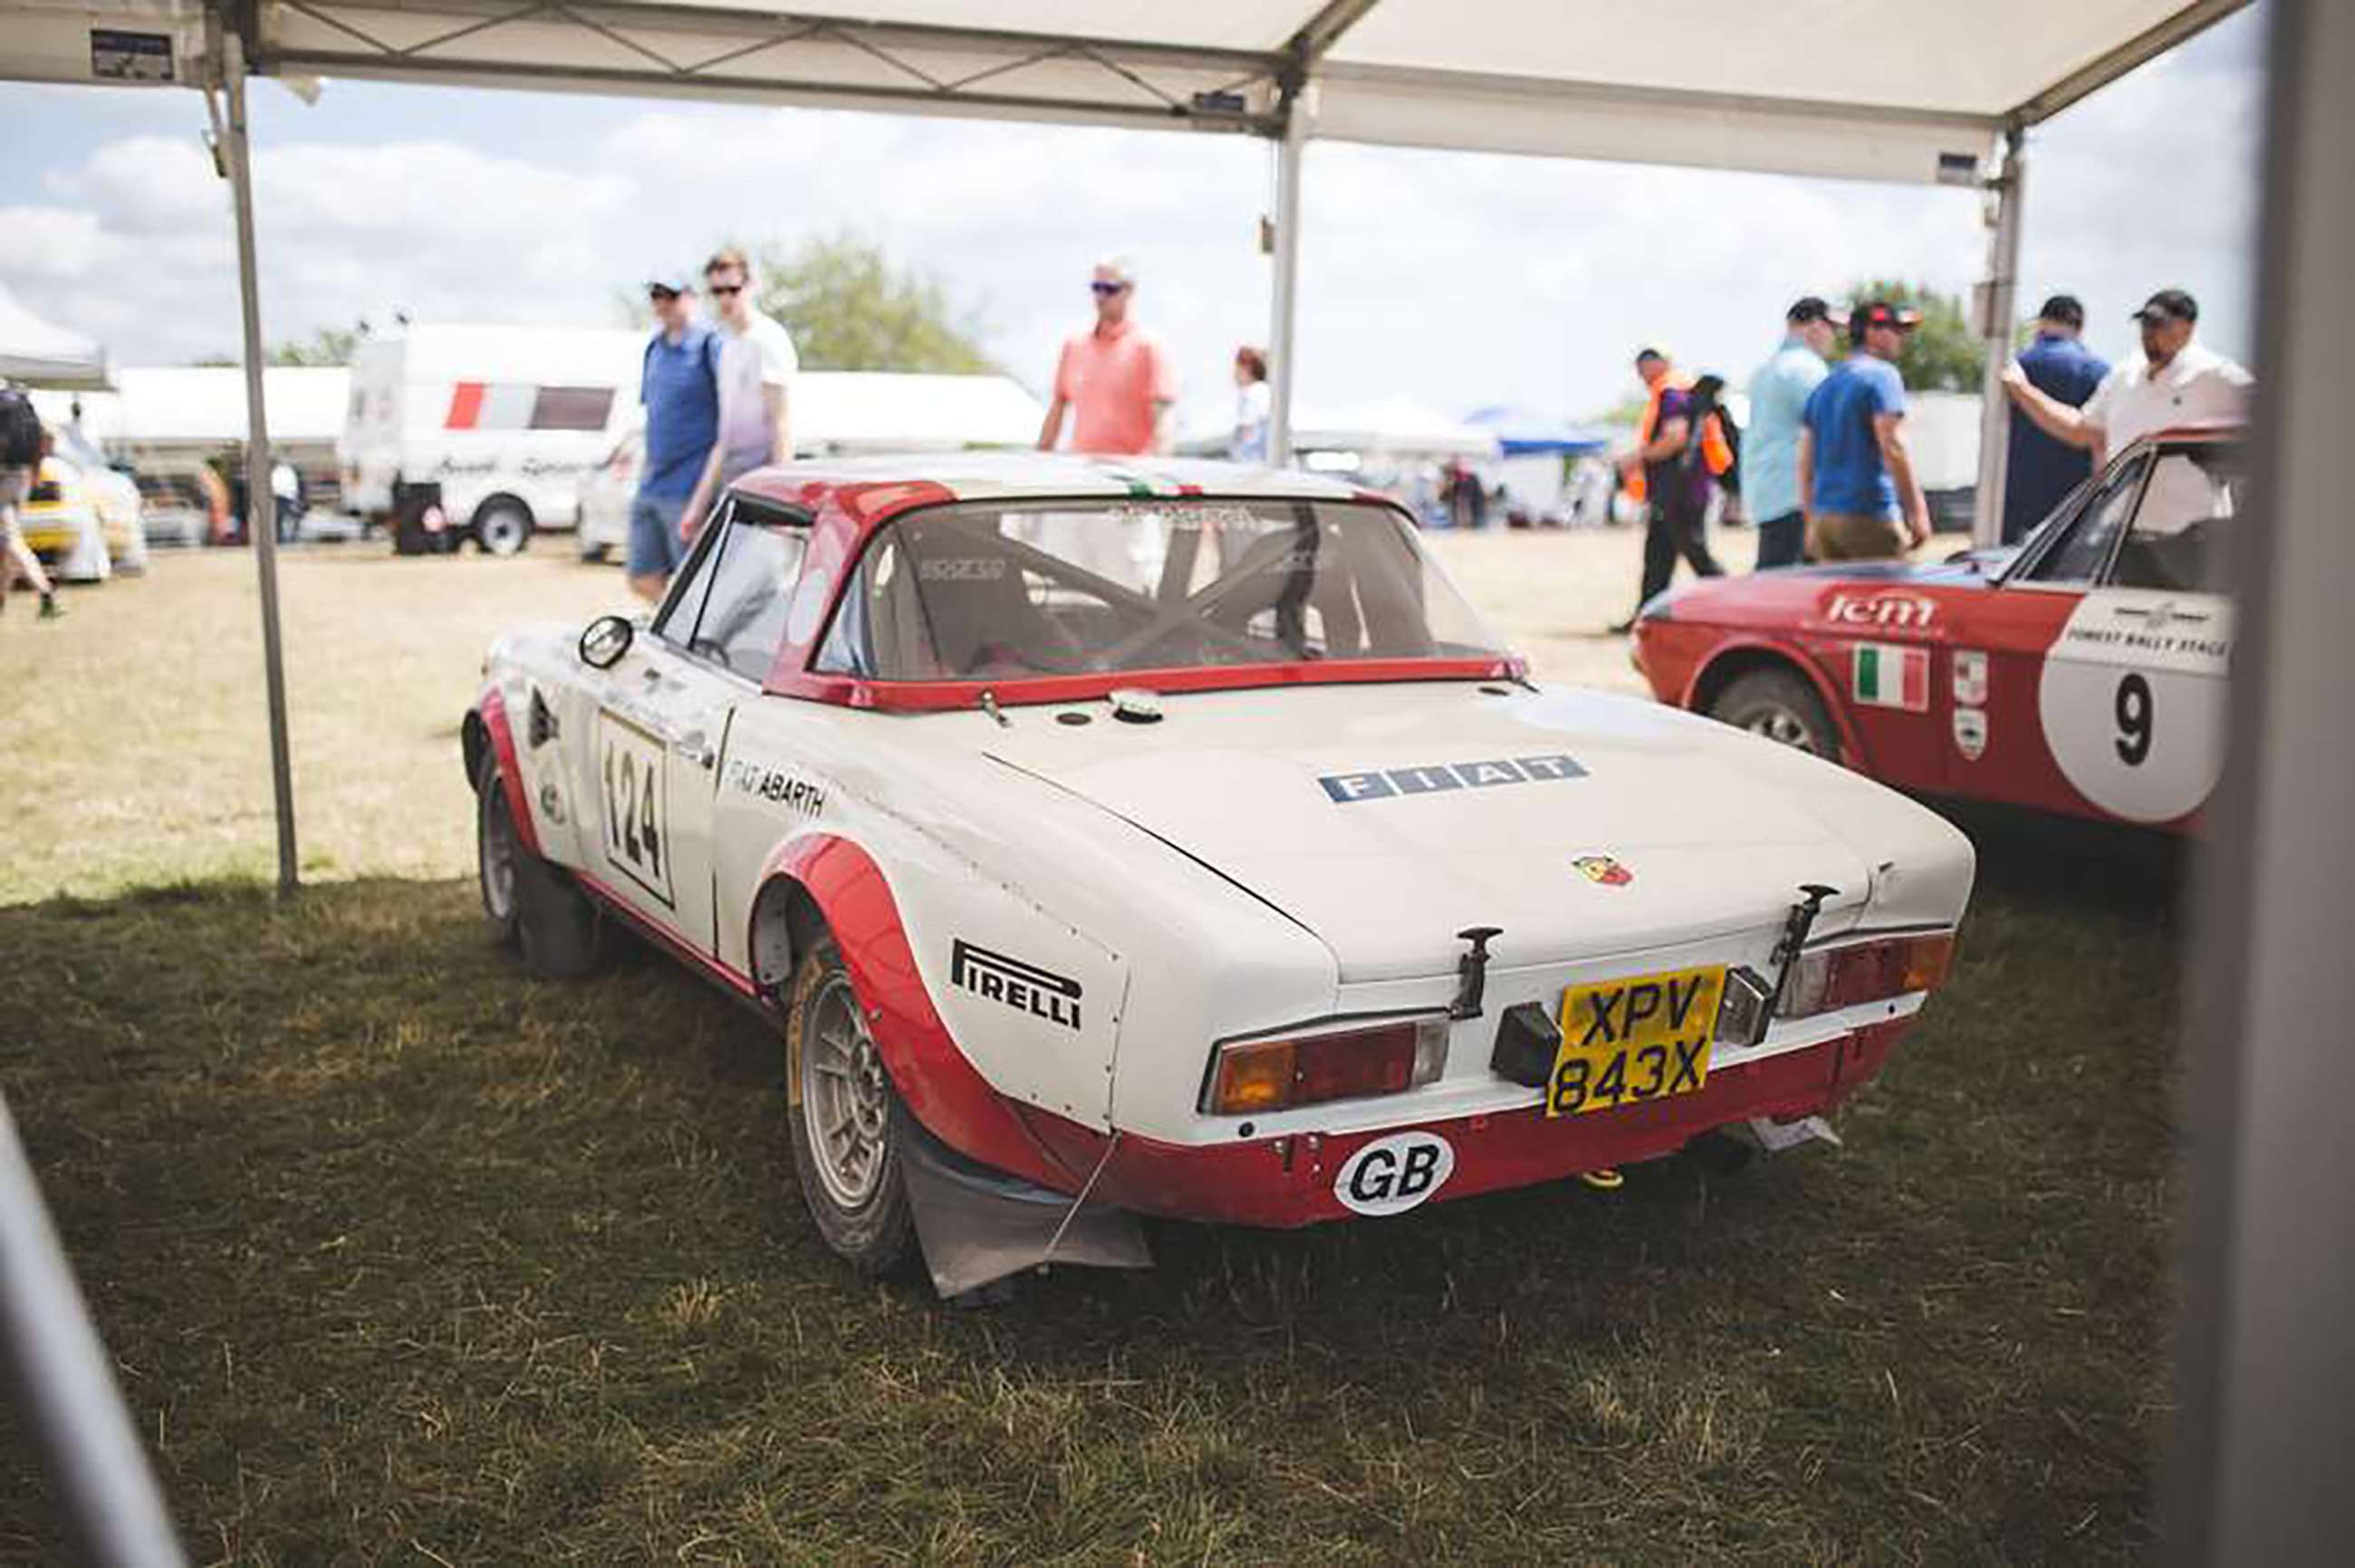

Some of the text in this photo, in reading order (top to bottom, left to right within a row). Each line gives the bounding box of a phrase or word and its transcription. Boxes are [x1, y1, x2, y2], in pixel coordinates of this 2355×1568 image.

[2115, 673, 2153, 766] 9
[604, 741, 660, 879] 124
[758, 769, 827, 818] ABARTH
[1328, 758, 1581, 800] FIAT
[951, 937, 1082, 1031] PIRELLI
[1581, 975, 1701, 1046] XPV
[1553, 1035, 1707, 1111] 843X
[1350, 1144, 1440, 1202] GB
